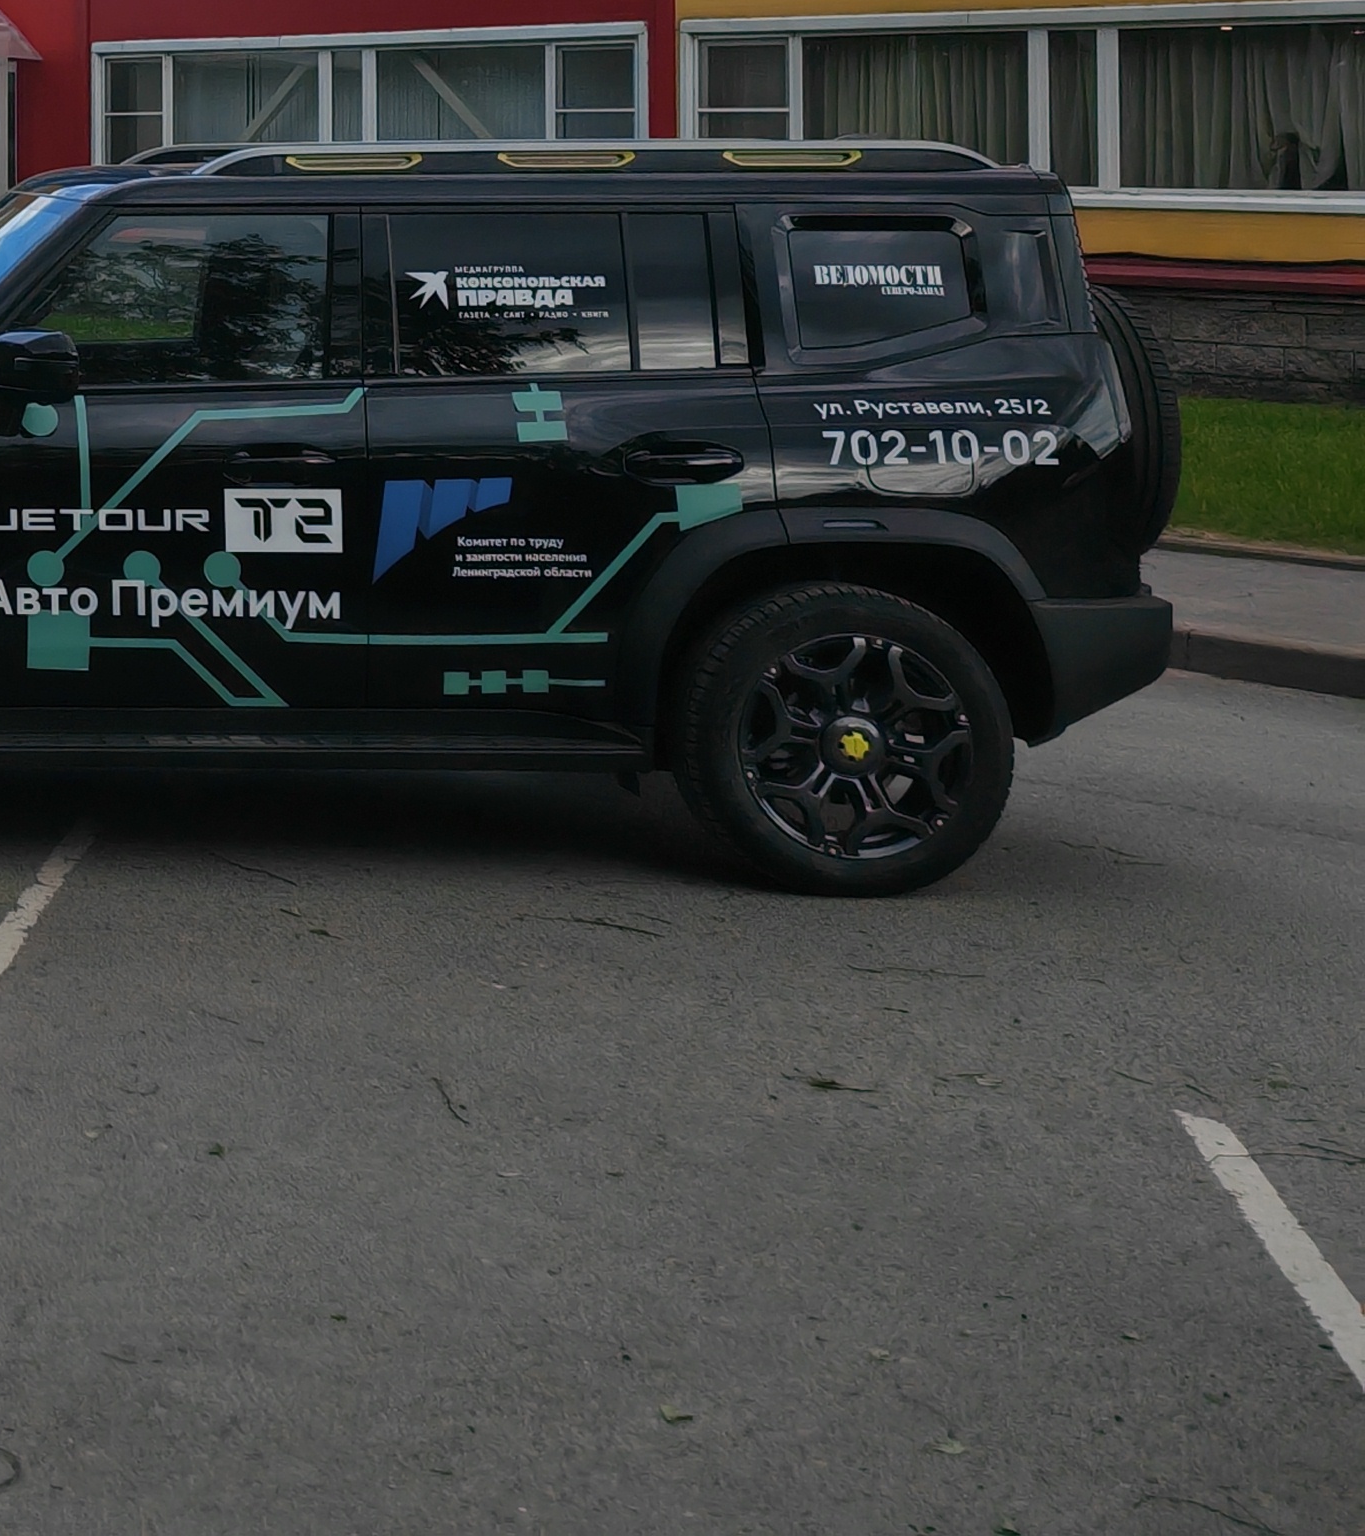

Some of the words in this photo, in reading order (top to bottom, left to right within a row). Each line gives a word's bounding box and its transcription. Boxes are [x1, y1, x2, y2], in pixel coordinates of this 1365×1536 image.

[455, 276, 606, 288] КОМСОМОЛЬСКАЯ
[813, 265, 943, 287] ВЕДОМОСТИ
[456, 289, 574, 308] ПРАВДА
[813, 402, 852, 420] ул.
[853, 399, 993, 419] Руставели,
[821, 429, 1060, 466] 702-10-02
[233, 497, 334, 544] T2
[457, 536, 509, 547] Комитет
[510, 537, 526, 547] по
[528, 537, 564, 549] труду
[455, 553, 463, 562] и
[465, 552, 523, 562] занятости
[525, 552, 588, 562] населения
[452, 566, 541, 579] Ленинградской
[543, 567, 593, 578] области
[111, 578, 342, 631] Премиум
